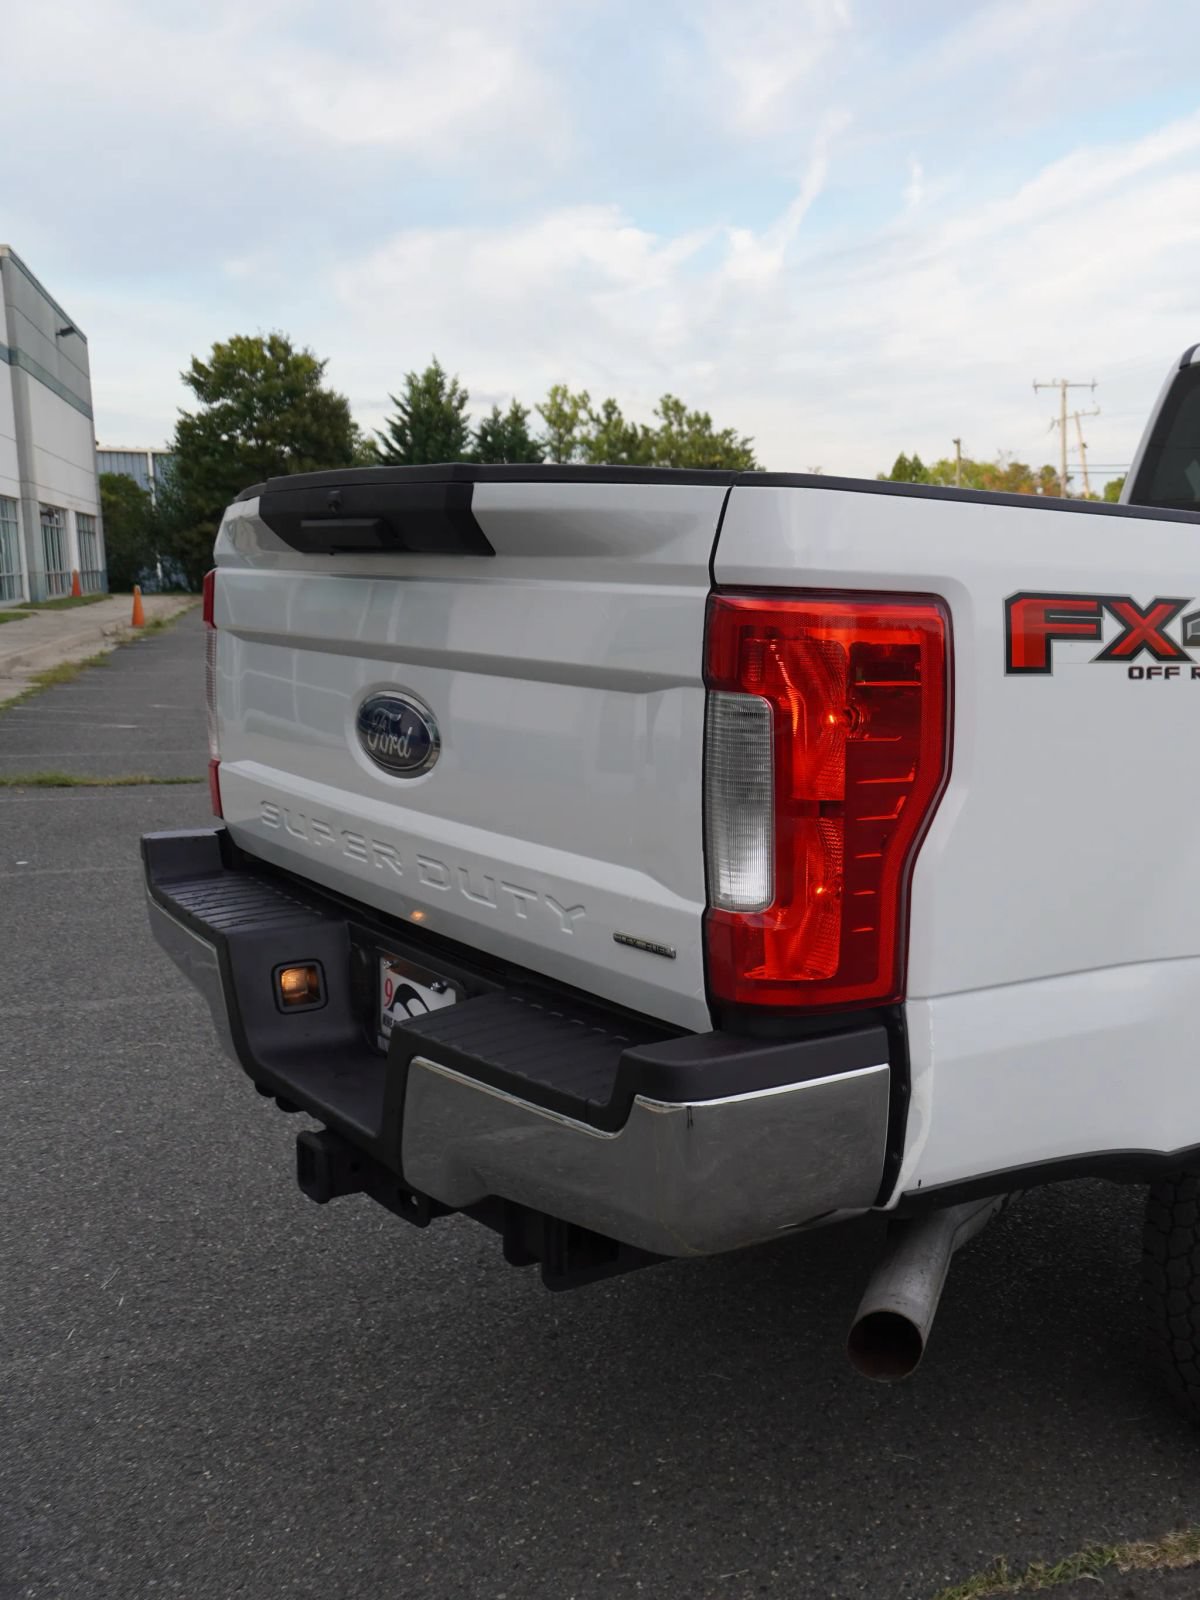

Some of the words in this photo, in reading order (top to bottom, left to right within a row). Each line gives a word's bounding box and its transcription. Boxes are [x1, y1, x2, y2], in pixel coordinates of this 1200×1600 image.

[1127, 666, 1180, 680] OFF
[367, 707, 413, 759] Ford
[260, 800, 403, 876] SUPER
[416, 853, 586, 935] DUTY
